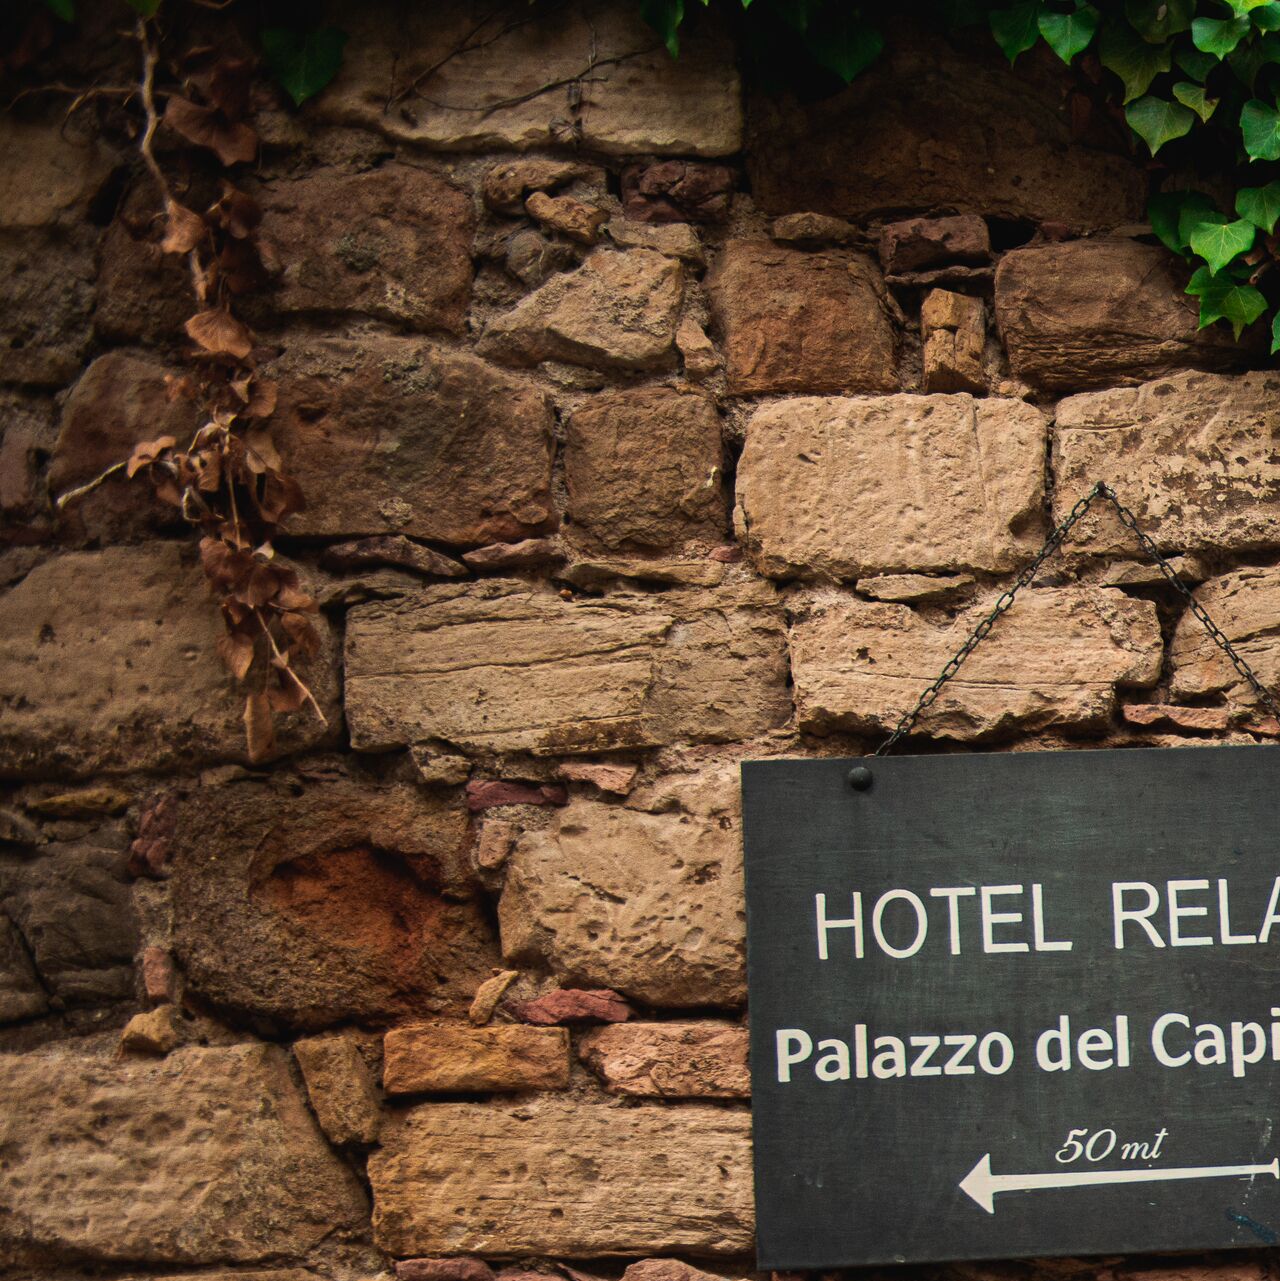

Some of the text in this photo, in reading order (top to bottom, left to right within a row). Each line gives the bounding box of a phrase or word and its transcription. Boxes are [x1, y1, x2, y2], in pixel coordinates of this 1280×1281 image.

[816, 884, 1074, 960] HOTEL
[775, 1024, 1014, 1082] Palazzo
[1036, 1015, 1130, 1072] del
[1054, 1127, 1169, 1164] 50 mt
